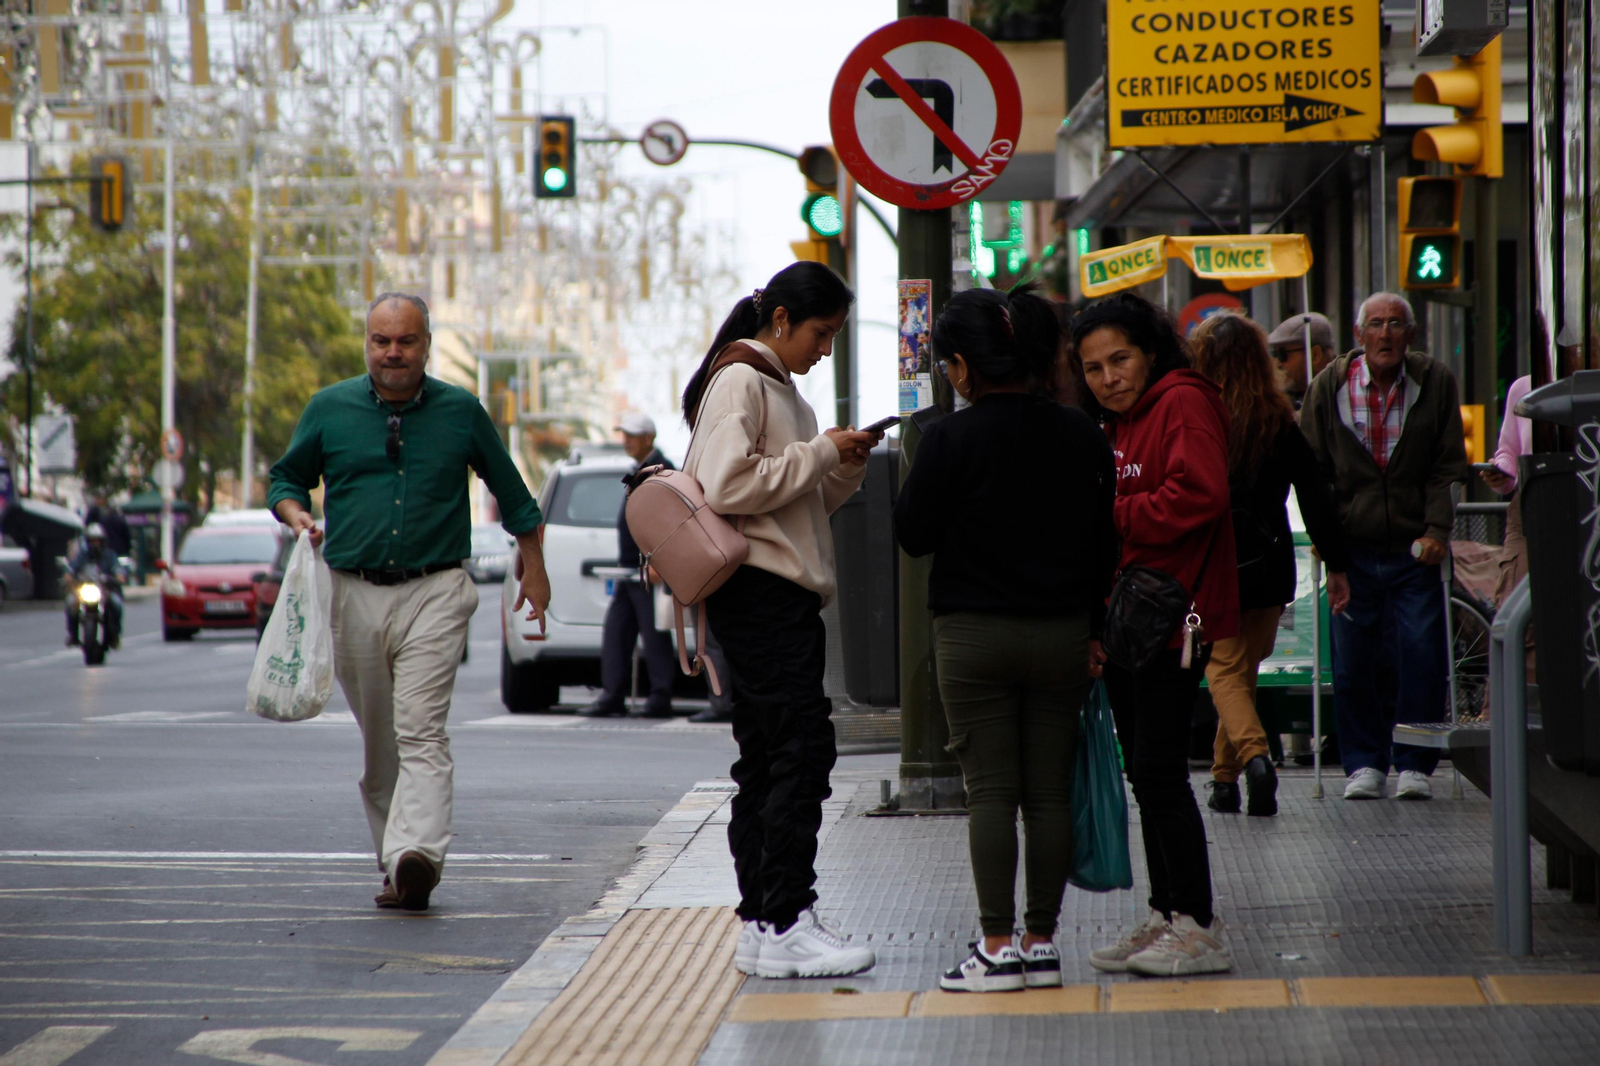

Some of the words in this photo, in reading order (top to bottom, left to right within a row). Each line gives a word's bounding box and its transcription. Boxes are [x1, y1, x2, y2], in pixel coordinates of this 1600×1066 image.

[1131, 6, 1354, 33] CONDUCTORES
[1154, 38, 1333, 64] CAZADORES
[1117, 72, 1267, 97] CERTIFICADOS
[1275, 68, 1371, 91] MEDICOS
[1141, 109, 1201, 126] CENTRO
[1205, 108, 1264, 123] MEDICO
[1267, 105, 1300, 121] ISLA
[1303, 104, 1347, 120] CHICA
[1108, 248, 1154, 275] ONCE
[1214, 249, 1265, 269] ONCE
[1003, 950, 1020, 959] FIL
[1033, 949, 1054, 958] FILA
